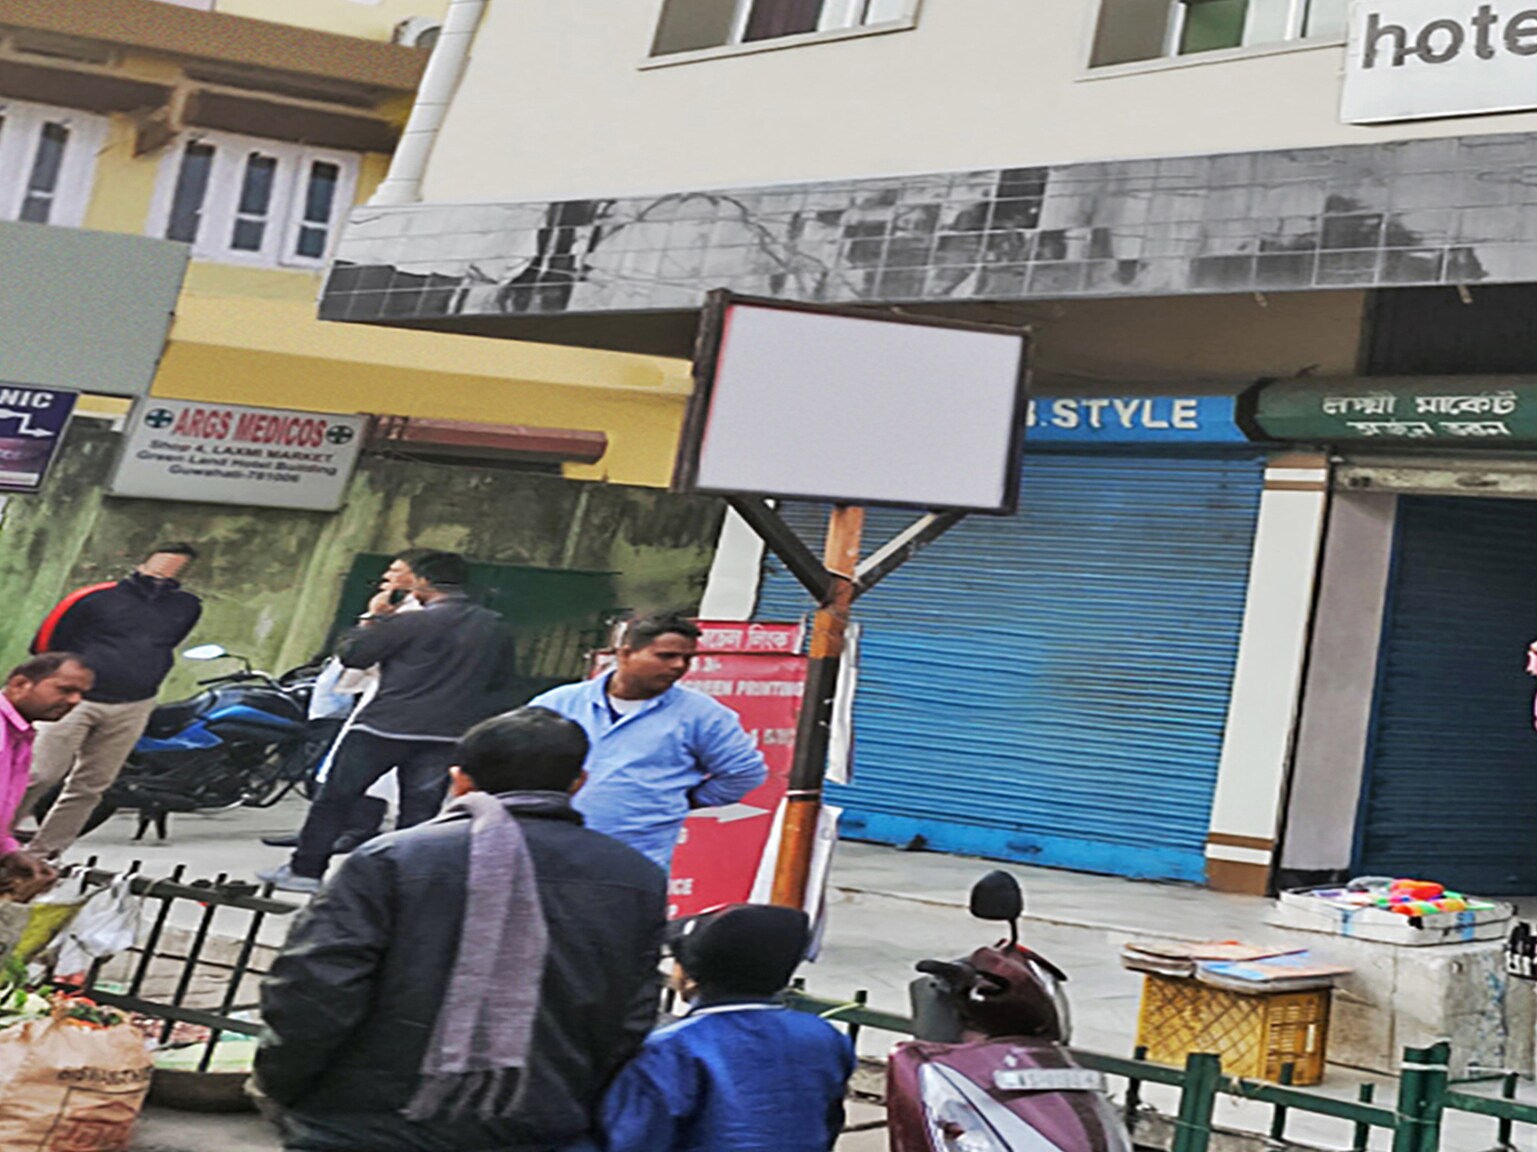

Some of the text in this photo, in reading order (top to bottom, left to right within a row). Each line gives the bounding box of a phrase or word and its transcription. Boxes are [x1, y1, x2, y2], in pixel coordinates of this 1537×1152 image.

[171, 407, 328, 448] ARGS MEDICOS
[136, 449, 184, 463] Green
[188, 453, 228, 467] Land
[212, 444, 265, 458] LAXMI
[266, 448, 334, 463] MARKET
